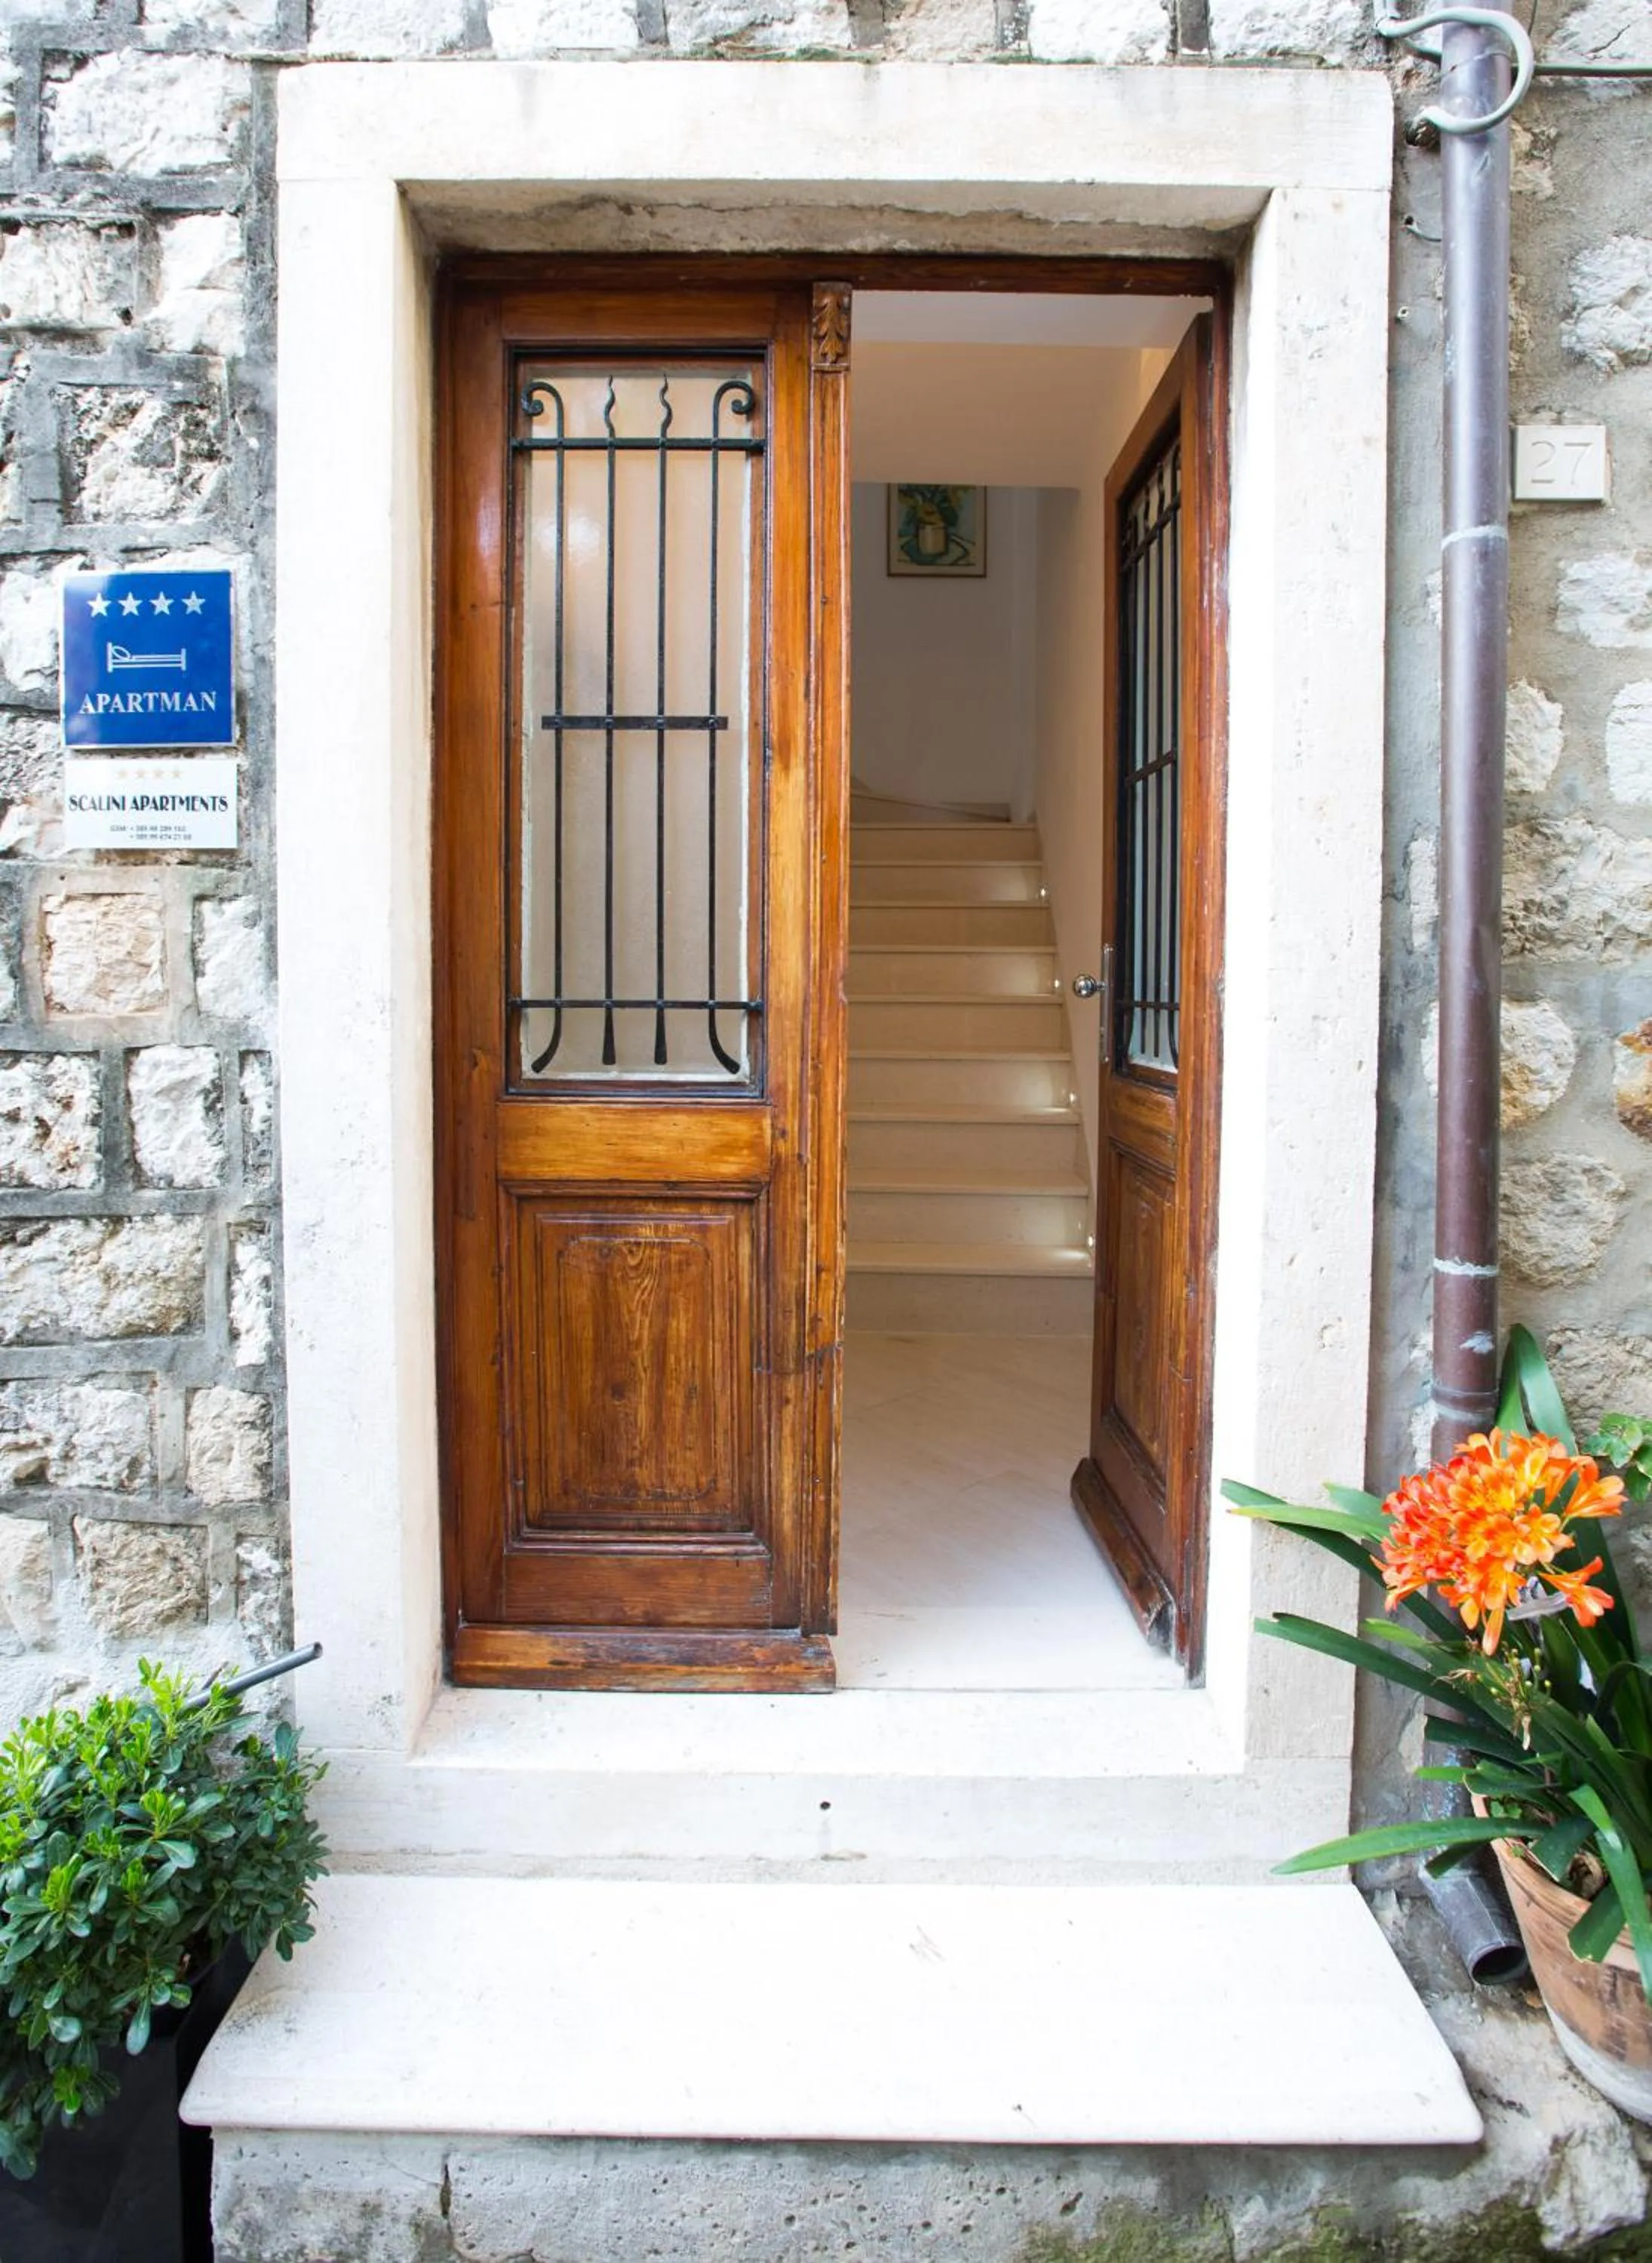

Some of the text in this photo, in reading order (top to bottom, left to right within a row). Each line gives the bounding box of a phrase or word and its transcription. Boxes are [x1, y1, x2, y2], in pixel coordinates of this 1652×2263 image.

[1531, 440, 1593, 485] 27
[79, 690, 216, 715] APARTMAN
[68, 794, 229, 812] SCALINI APARTMENTS
